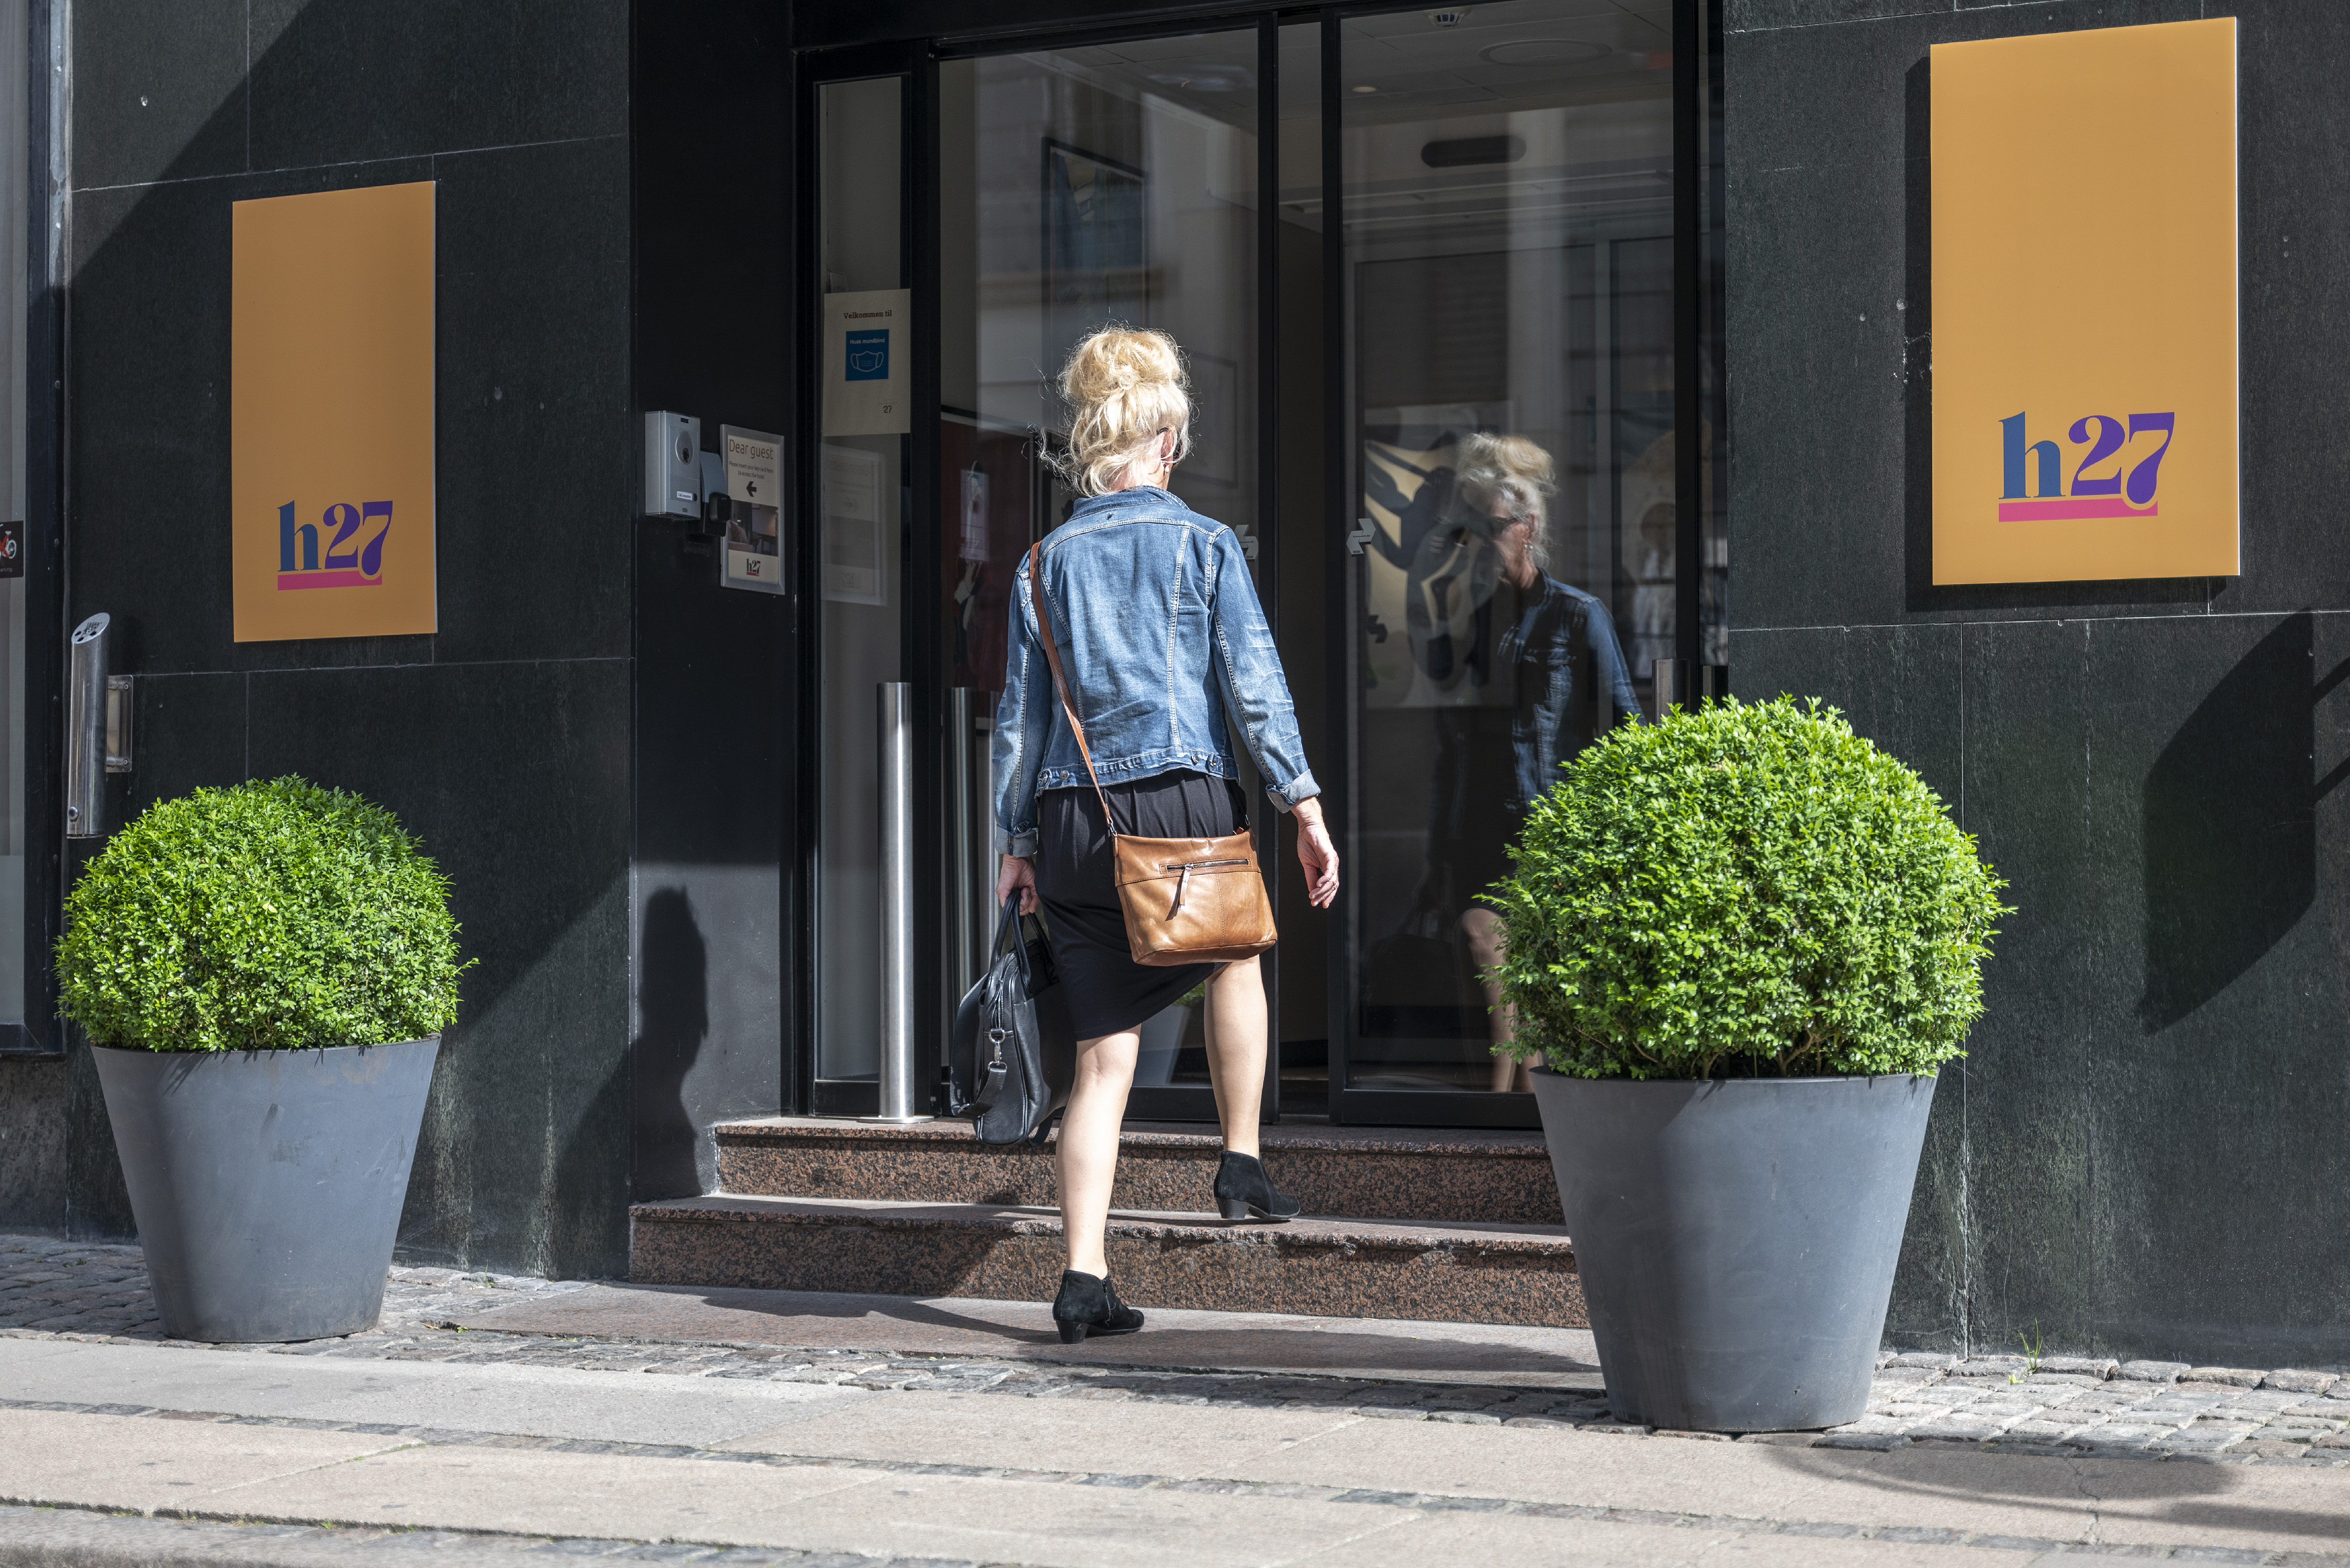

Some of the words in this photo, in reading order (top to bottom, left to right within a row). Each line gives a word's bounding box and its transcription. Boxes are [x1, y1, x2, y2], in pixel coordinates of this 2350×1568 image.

[729, 439, 748, 455] Dear
[750, 446, 773, 460] guest
[1998, 411, 2174, 504] h27
[277, 500, 393, 575] h27
[746, 558, 761, 574] h27
